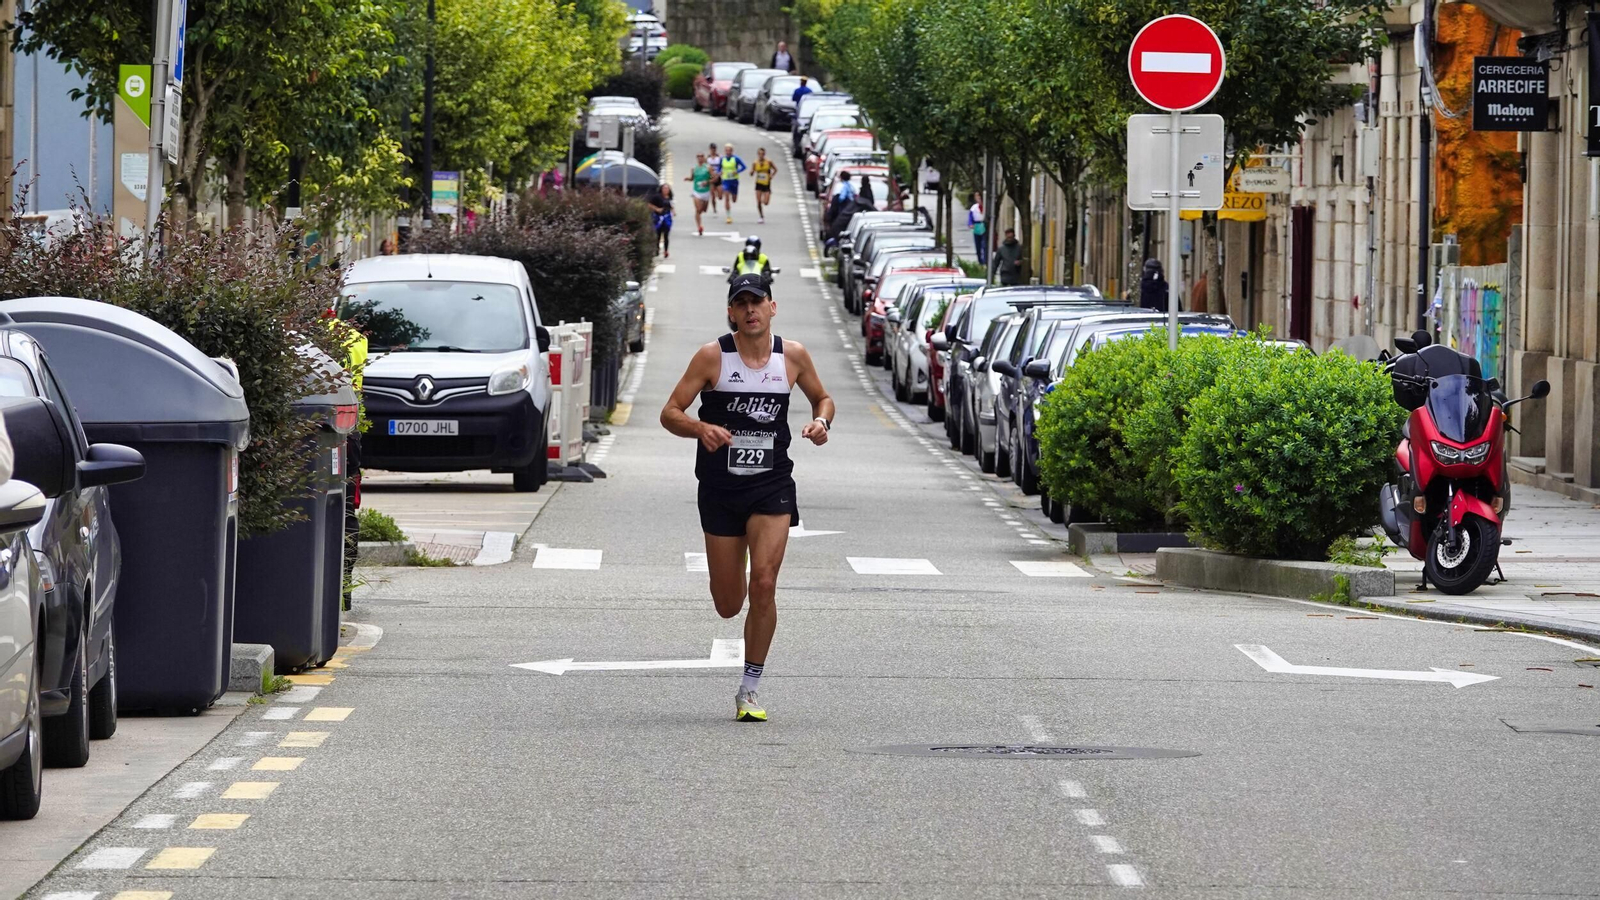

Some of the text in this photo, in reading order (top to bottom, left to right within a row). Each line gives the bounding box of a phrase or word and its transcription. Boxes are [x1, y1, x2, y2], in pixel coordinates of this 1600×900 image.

[1478, 65, 1545, 75] CERVECERIA
[1477, 79, 1546, 94] ARRECIFE
[1487, 103, 1535, 116] Mahou
[397, 422, 455, 434] 0700 JHL
[736, 449, 765, 465] 229
